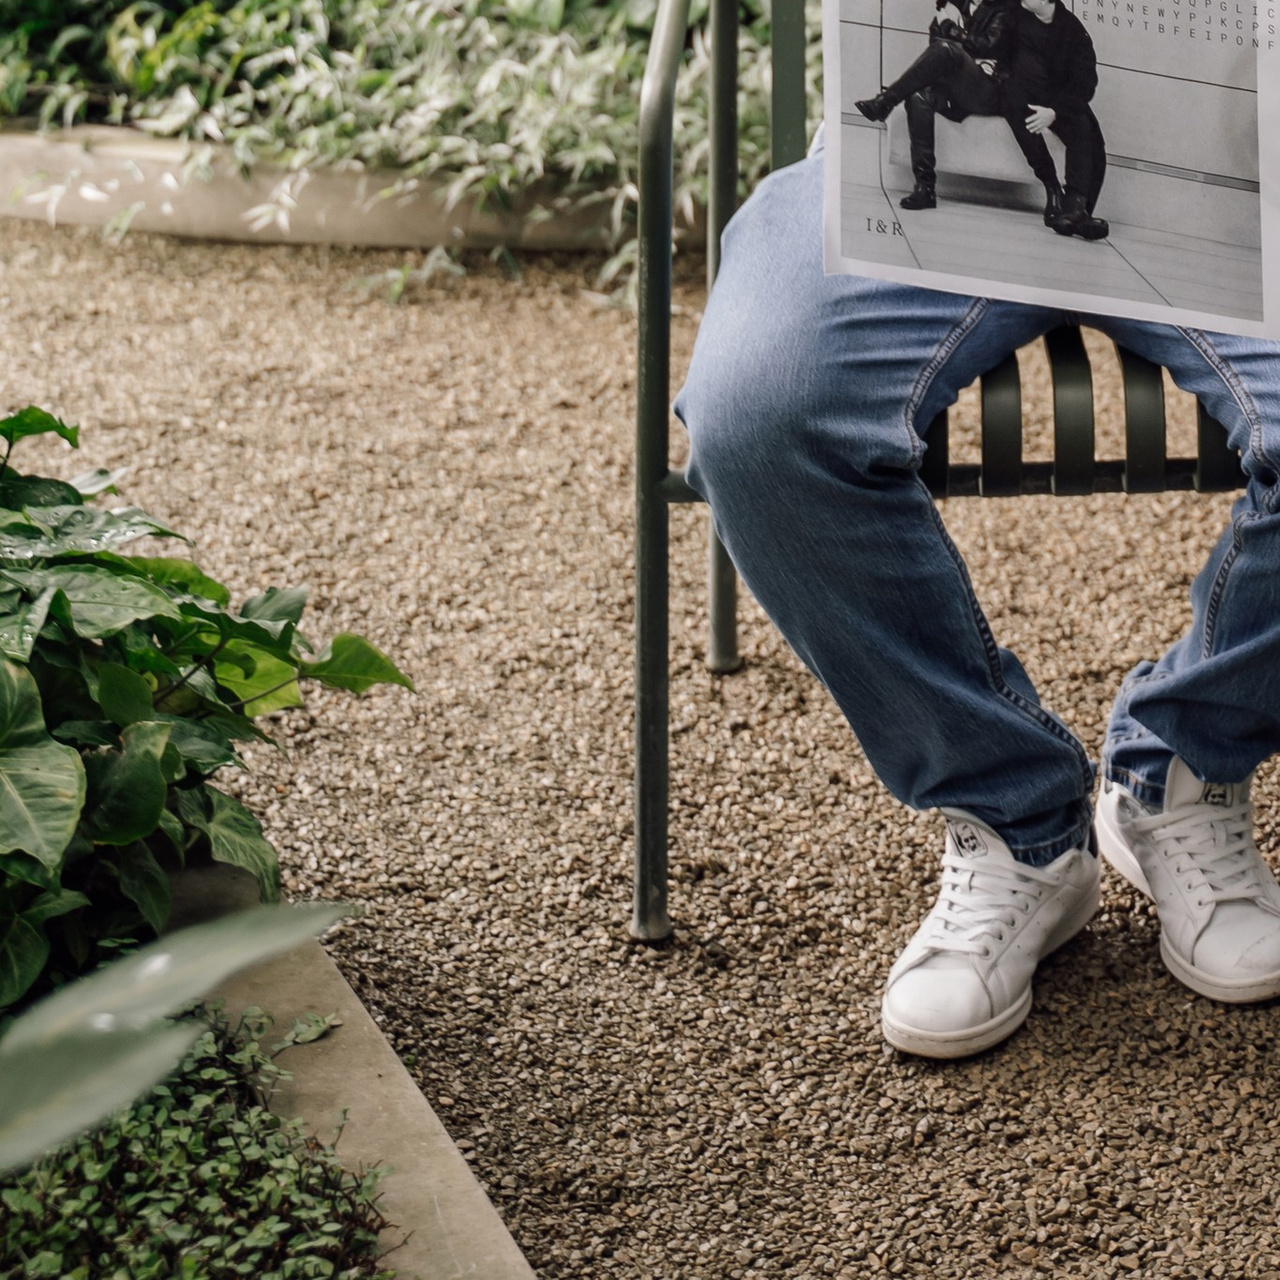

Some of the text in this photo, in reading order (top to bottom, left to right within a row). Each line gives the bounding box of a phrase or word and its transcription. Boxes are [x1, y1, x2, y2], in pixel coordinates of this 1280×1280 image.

[866, 217, 904, 237] I & R
